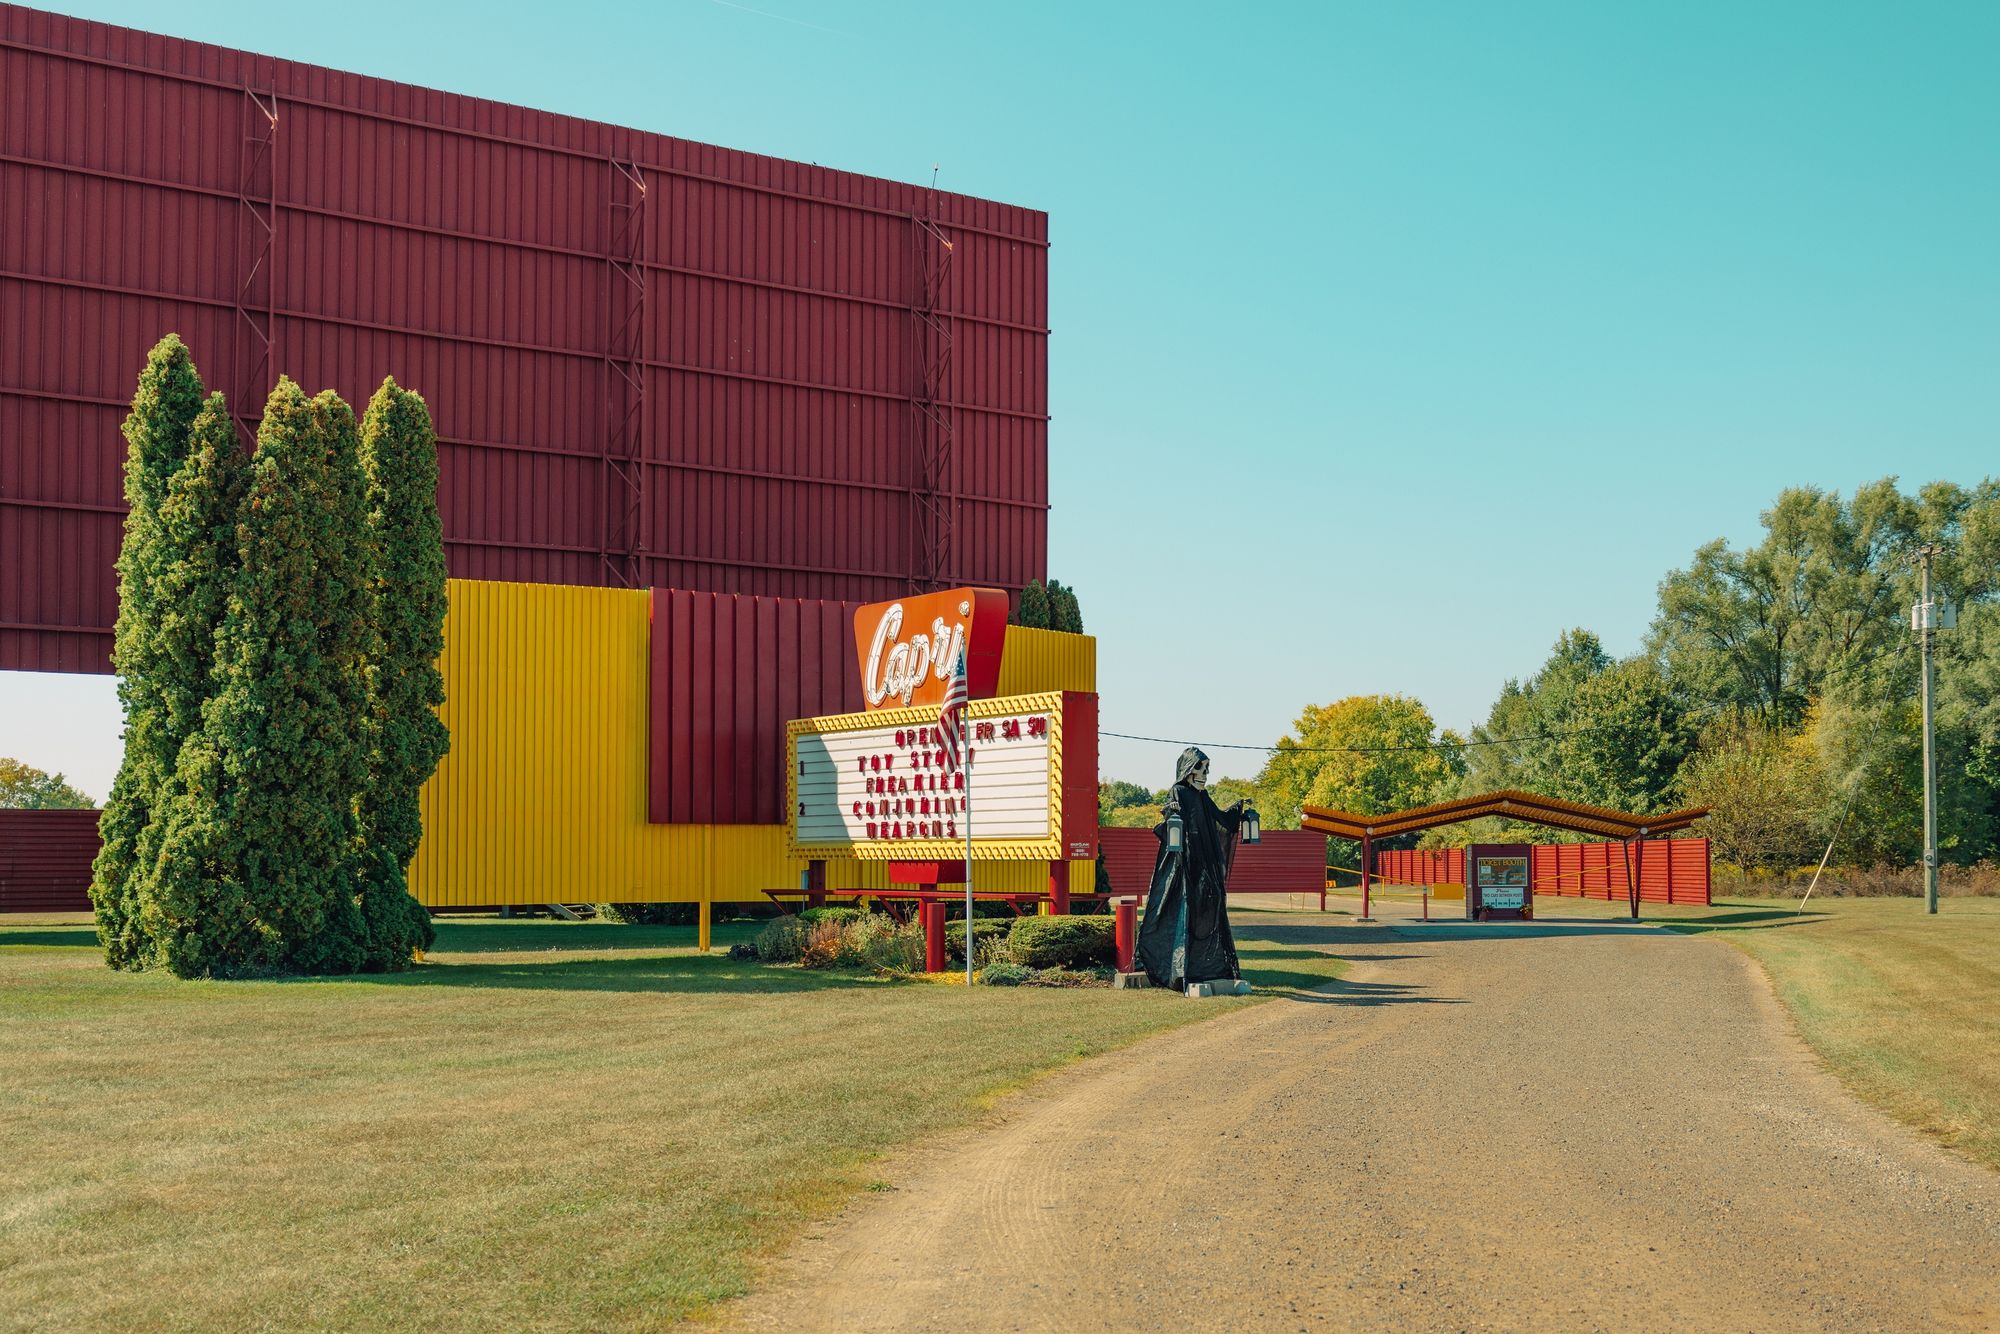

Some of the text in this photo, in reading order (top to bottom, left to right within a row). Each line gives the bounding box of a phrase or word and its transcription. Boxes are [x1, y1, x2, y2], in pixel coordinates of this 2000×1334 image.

[865, 601, 970, 707] Capri
[976, 721, 994, 740] FR
[1001, 718, 1020, 738] SA
[1027, 716, 1047, 736] SU
[858, 753, 893, 772] TOY
[866, 771, 965, 793] FREAKIER
[799, 802, 806, 816] 2
[866, 819, 956, 839] WEAPONS
